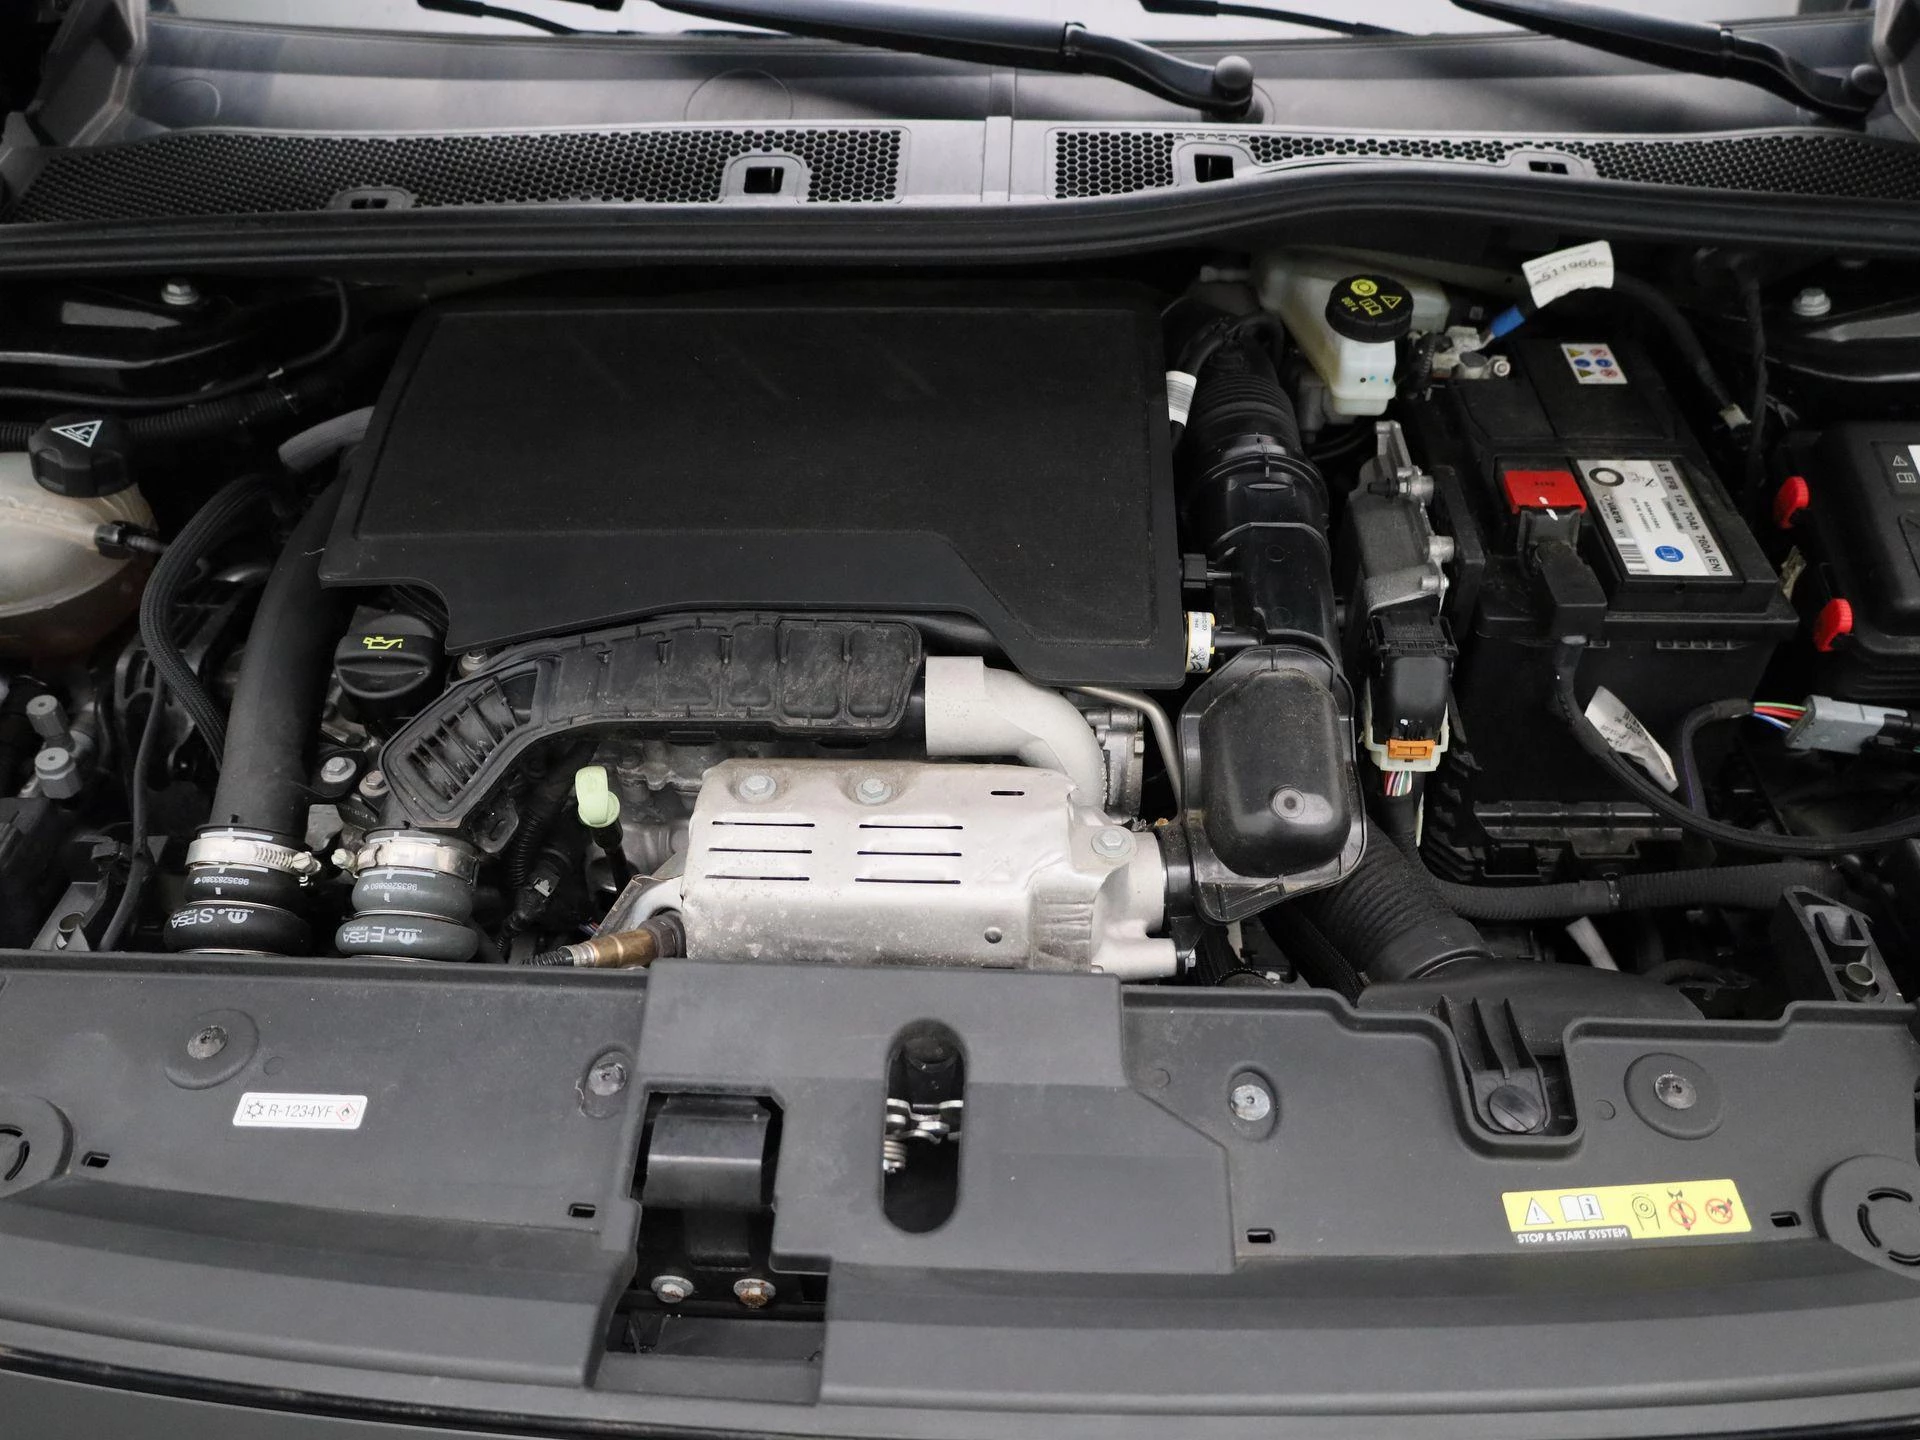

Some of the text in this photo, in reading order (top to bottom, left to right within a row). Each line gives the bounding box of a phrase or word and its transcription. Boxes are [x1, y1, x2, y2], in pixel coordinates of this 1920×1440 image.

[1607, 500, 1623, 524] VARTA
[1674, 494, 1688, 508] 12V
[1683, 511, 1700, 531] 70Ah
[1706, 555, 1723, 572] (EN)
[171, 913, 198, 928] PSA
[343, 931, 369, 943] PSA
[267, 1103, 334, 1118] R-1234YF
[1517, 1227, 1628, 1244] STOP & START SYSTEM
